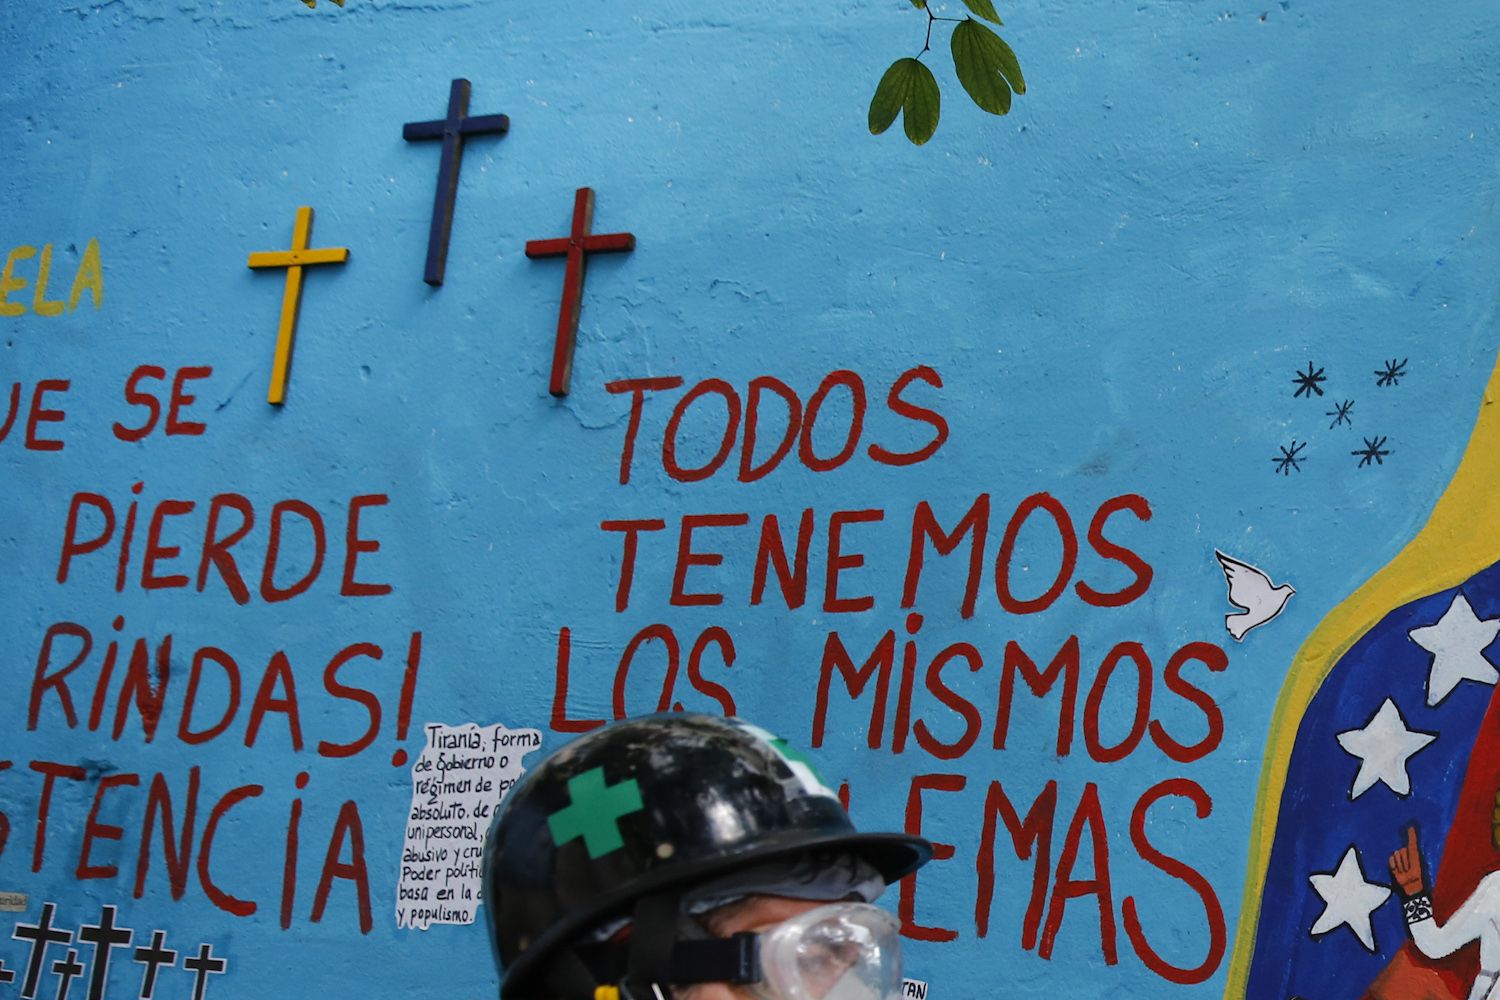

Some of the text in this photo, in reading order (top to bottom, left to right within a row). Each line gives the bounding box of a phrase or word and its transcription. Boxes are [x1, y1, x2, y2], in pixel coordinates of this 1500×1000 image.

[112, 364, 213, 442] SE
[605, 365, 949, 485] TODOS
[601, 491, 1153, 619] TENEMOS
[549, 624, 736, 734] LOS
[492, 726, 542, 753] forma
[415, 754, 432, 772] de
[500, 756, 509, 768] o
[416, 777, 471, 806] régimen
[475, 776, 492, 793] de
[473, 800, 489, 818] de
[0, 758, 373, 934] TENCIA
[407, 822, 484, 850] unipersonal,
[403, 846, 448, 862] abusivo
[454, 848, 461, 866] y
[402, 866, 441, 882] Poder
[400, 883, 429, 901] basa
[436, 889, 454, 900] en
[461, 883, 472, 900] la
[398, 904, 473, 927] y populismo.
